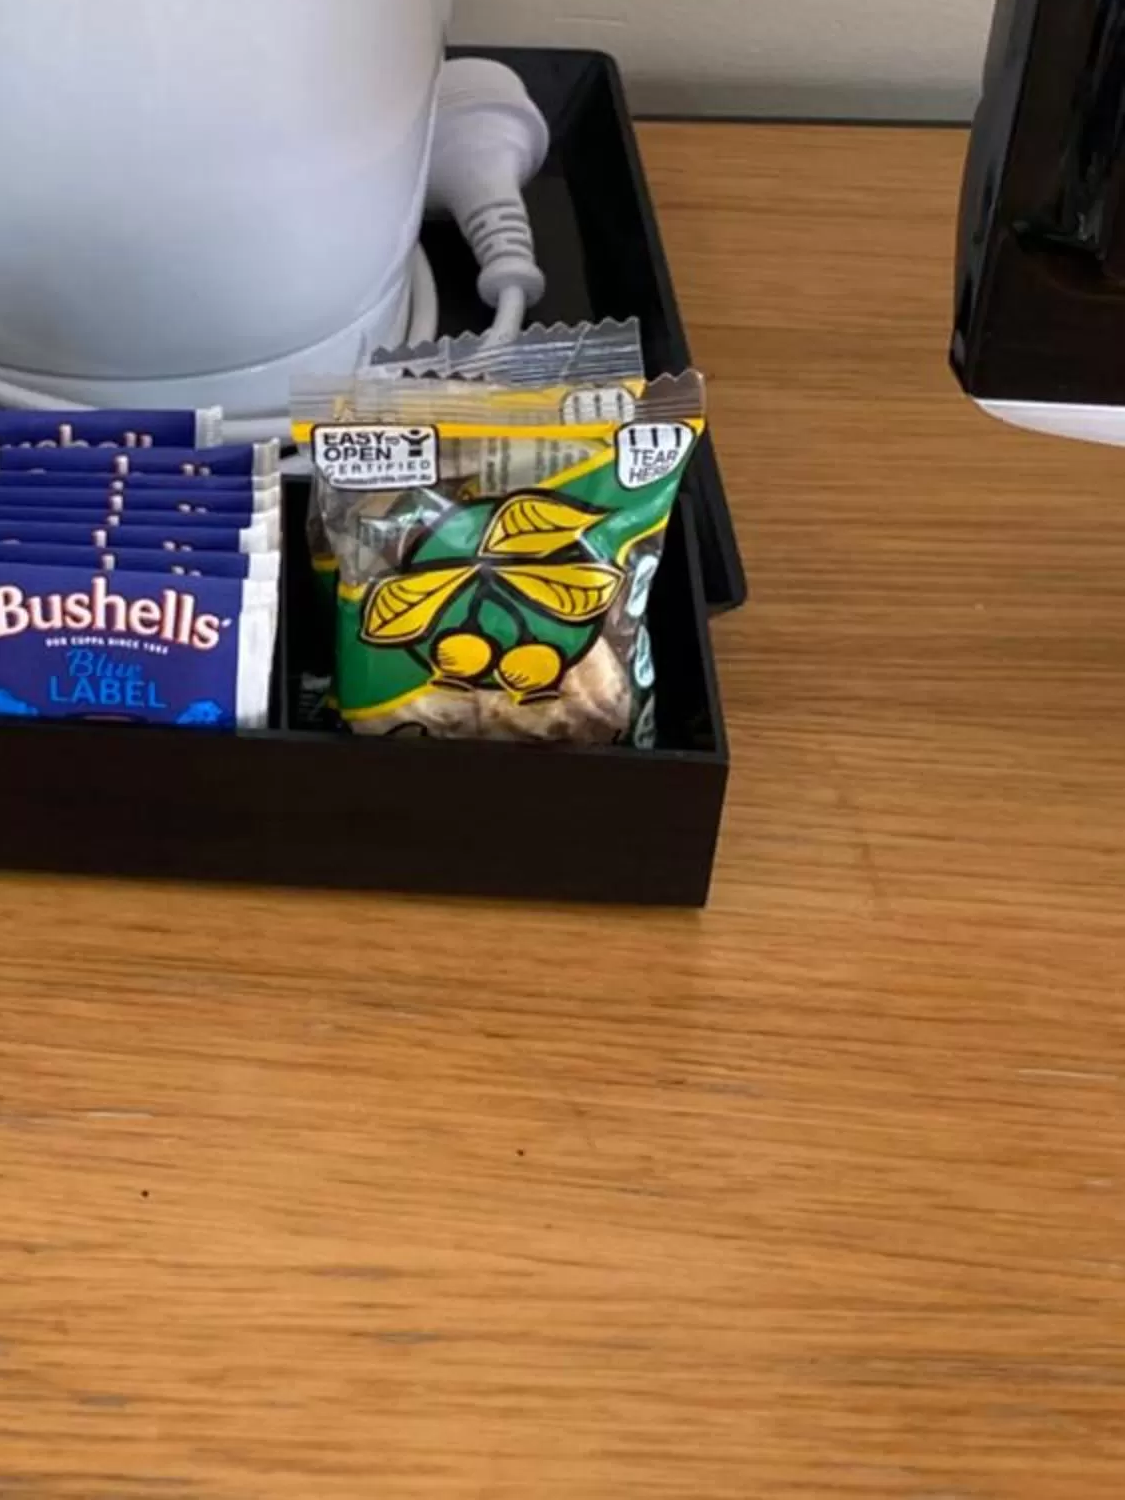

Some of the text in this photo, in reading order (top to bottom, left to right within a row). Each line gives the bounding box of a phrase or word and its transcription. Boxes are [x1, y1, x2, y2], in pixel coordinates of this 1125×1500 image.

[324, 431, 384, 445] EASY
[324, 447, 391, 461] OPEN
[629, 449, 680, 466] TEAR
[324, 460, 431, 477] CERTIFIED
[66, 648, 143, 678] Blue
[50, 675, 167, 708] LABEL
